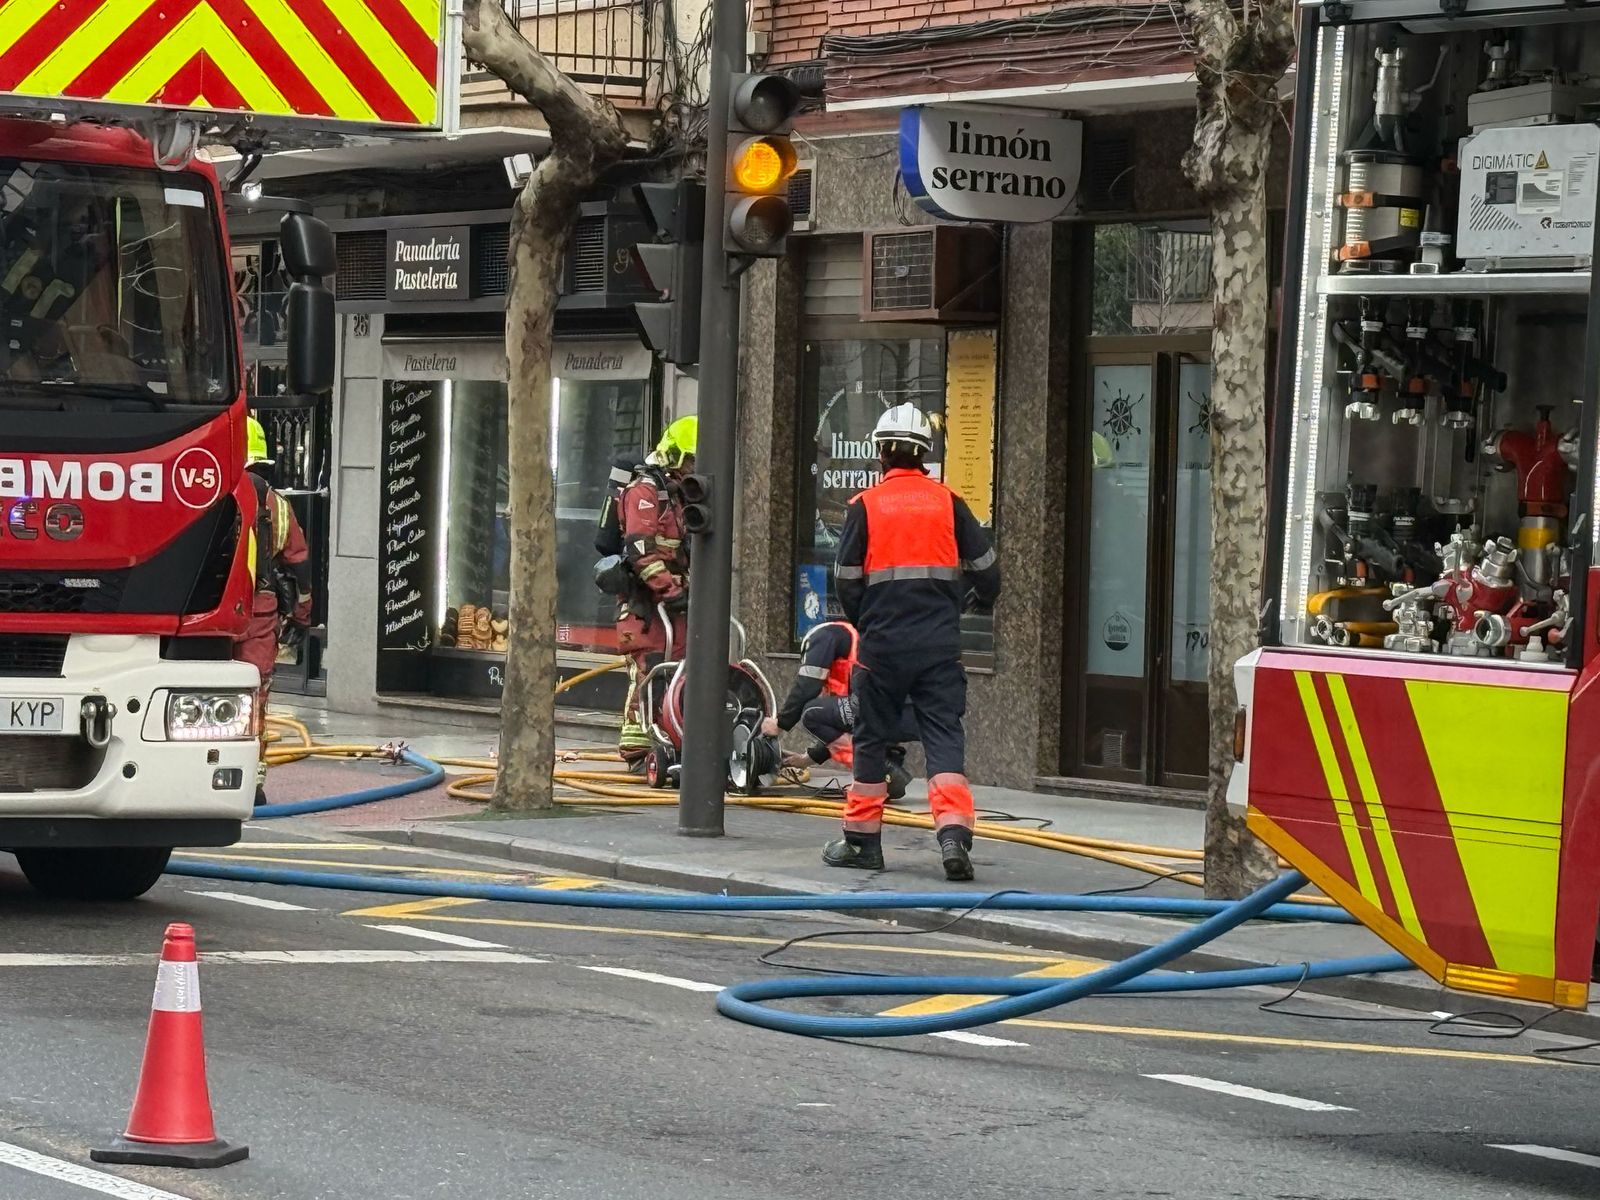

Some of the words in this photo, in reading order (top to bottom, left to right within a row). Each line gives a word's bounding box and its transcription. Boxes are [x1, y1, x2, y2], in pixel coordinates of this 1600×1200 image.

[948, 120, 1052, 162] limón
[1472, 153, 1535, 170] DIGIMATIC
[931, 166, 1066, 200] serrano
[394, 235, 460, 262] Panadería
[394, 265, 458, 290] Pastelería
[179, 468, 217, 489] V-5
[823, 469, 884, 490] serran
[0, 502, 85, 541] CO
[10, 701, 55, 727] KYP
